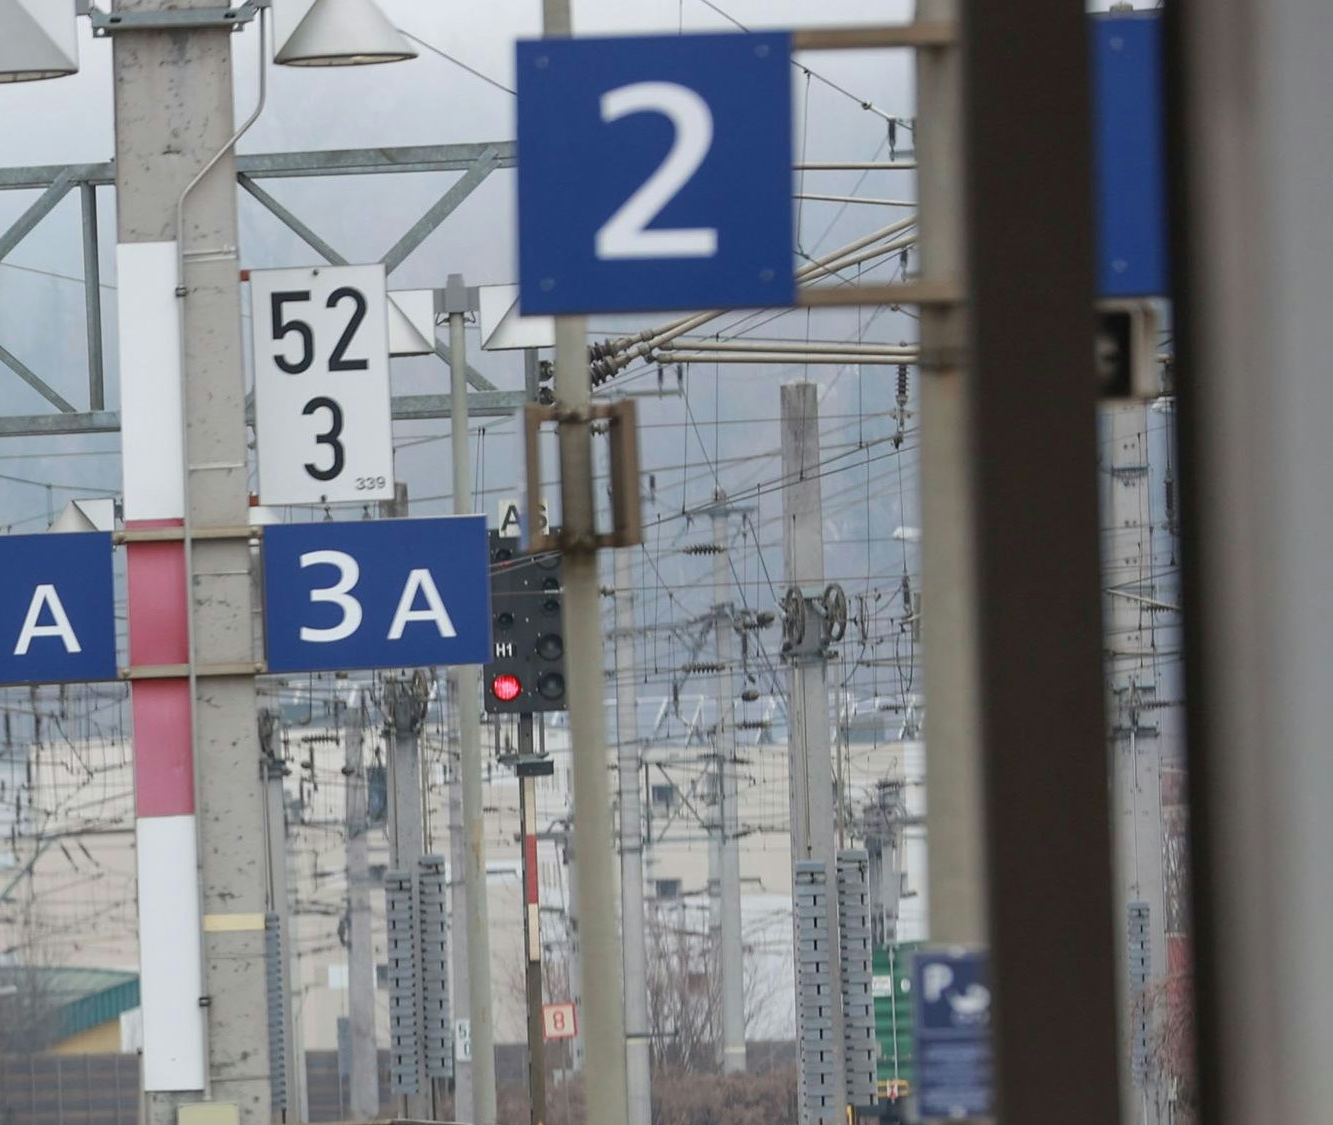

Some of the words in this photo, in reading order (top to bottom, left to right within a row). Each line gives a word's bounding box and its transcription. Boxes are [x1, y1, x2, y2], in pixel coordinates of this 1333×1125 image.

[594, 80, 719, 262] 2
[270, 286, 369, 375] 52
[301, 396, 346, 481] 3
[355, 476, 387, 491] 339
[13, 583, 83, 656] A
[299, 549, 364, 643] 3
[386, 568, 458, 641] A
[495, 642, 513, 658] H1
[552, 1010, 565, 1032] 8
